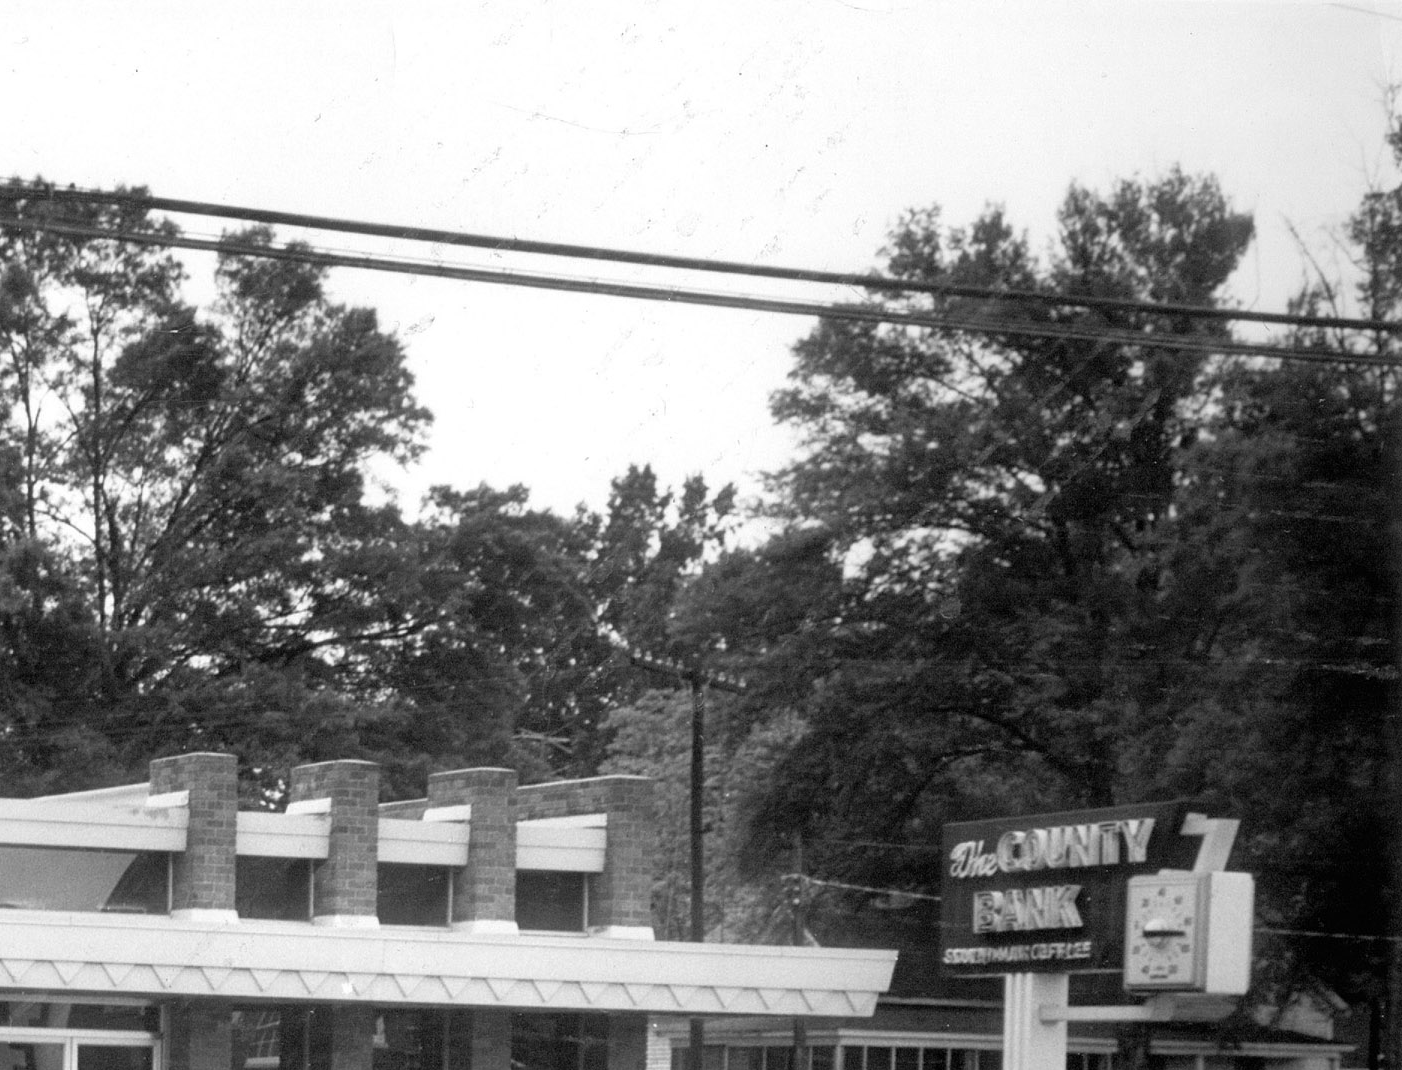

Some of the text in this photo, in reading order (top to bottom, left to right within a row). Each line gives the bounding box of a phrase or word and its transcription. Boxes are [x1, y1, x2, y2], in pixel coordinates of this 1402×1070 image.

[950, 818, 1156, 878] The COUNTY
[973, 884, 1084, 934] BANK
